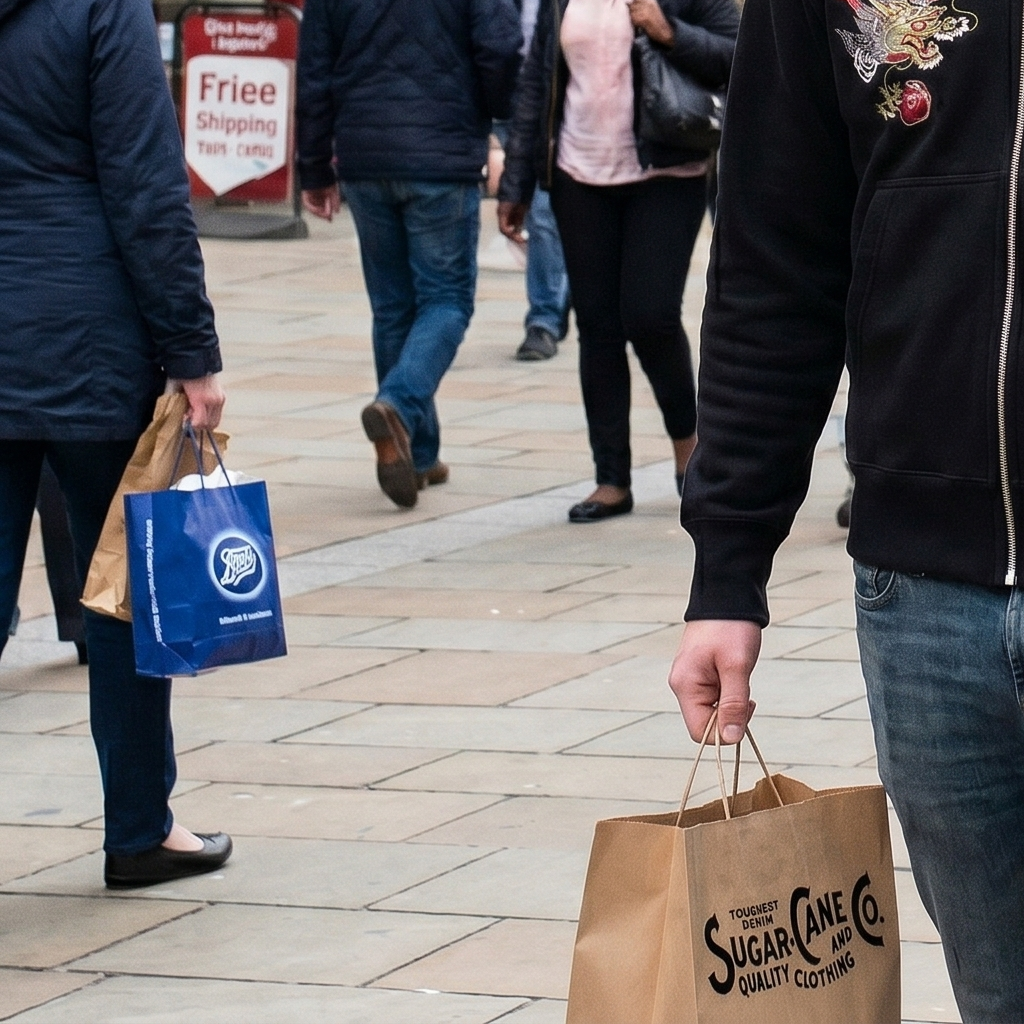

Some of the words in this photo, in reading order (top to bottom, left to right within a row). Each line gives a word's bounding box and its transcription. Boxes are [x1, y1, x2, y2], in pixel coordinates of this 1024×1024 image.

[200, 72, 277, 105] Friee
[196, 110, 278, 138] Shipping
[742, 914, 775, 931] DENIM
[831, 926, 853, 955] AND
[738, 963, 790, 999] QUALITY
[794, 950, 856, 990] CLOTHING
